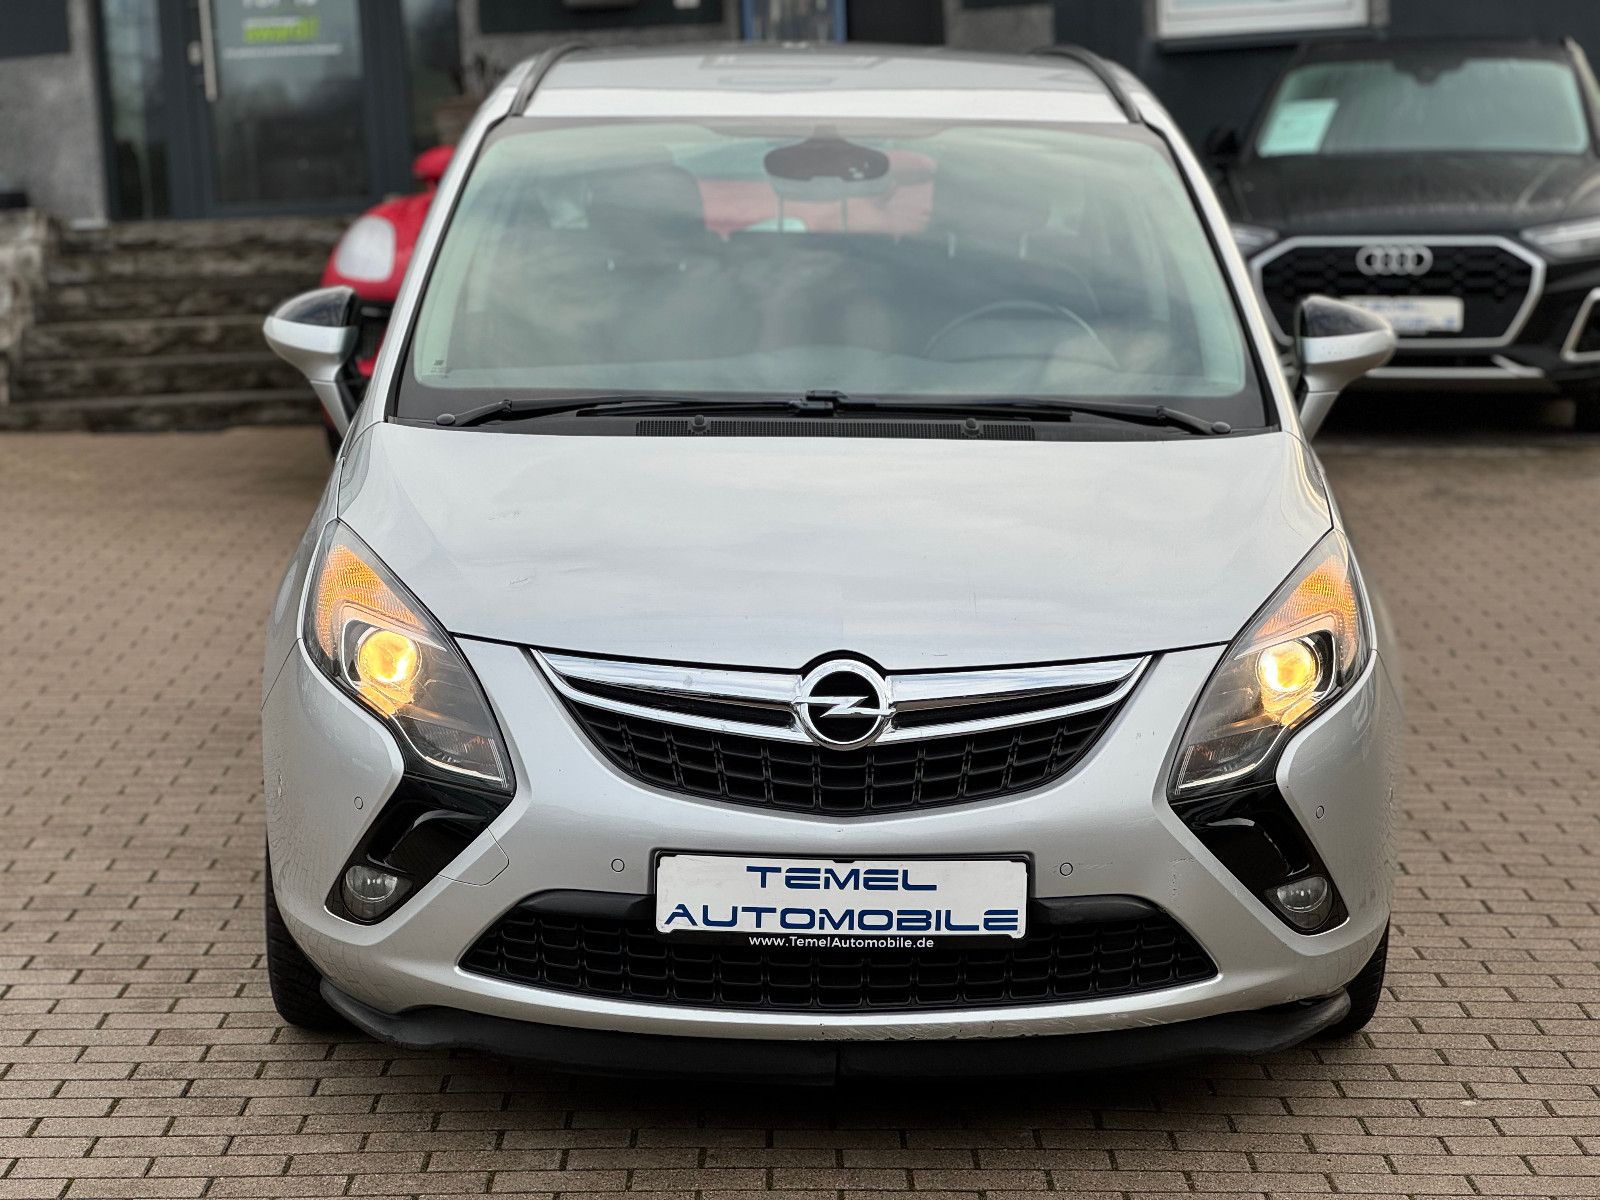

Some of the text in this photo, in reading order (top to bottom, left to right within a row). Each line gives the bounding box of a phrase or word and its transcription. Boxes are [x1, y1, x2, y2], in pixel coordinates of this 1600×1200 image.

[746, 865, 938, 891] TEMEL
[664, 903, 1019, 932] AUTOMOBILE
[748, 936, 935, 949] www.TemelAutomobile.de
